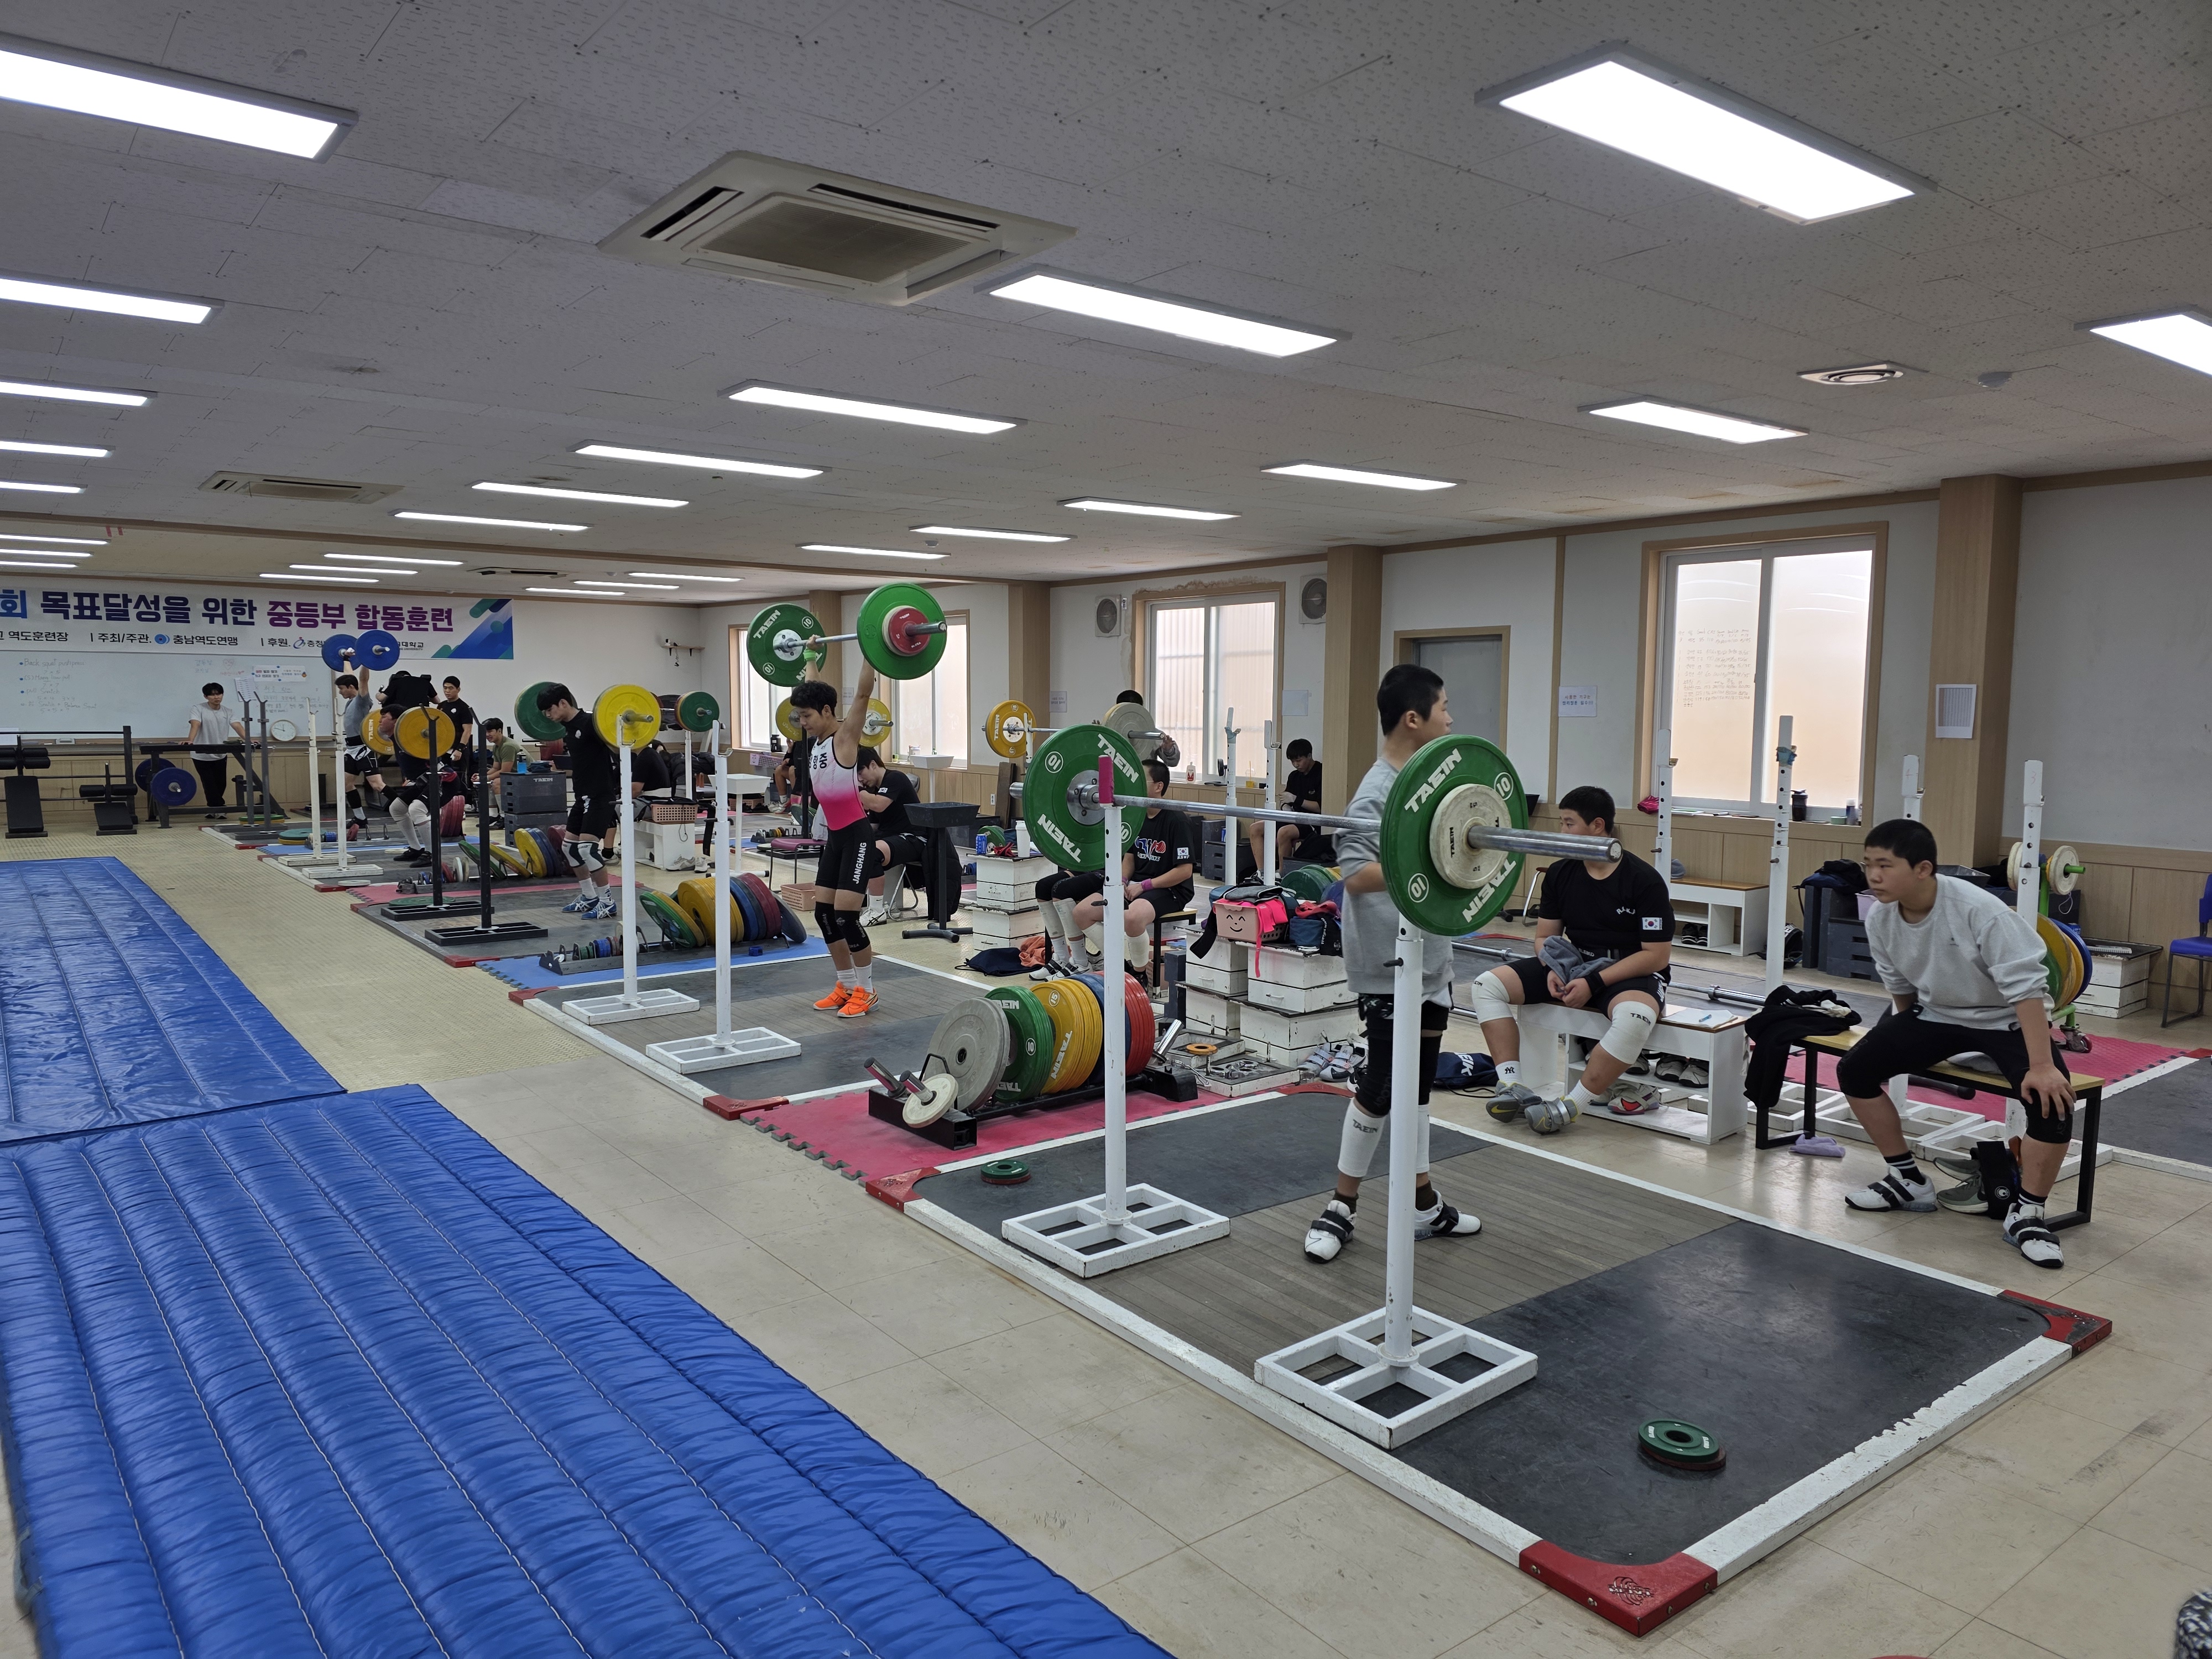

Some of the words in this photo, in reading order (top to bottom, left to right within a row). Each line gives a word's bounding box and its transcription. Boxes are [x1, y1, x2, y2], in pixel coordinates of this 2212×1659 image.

[40, 591, 191, 624] 목표달성을
[201, 598, 257, 626] 위한
[267, 600, 347, 629] 중등부
[354, 604, 453, 632] 합동훈련
[753, 609, 781, 639] TAEIN
[804, 619, 812, 627] 10
[8, 630, 69, 642] 역도훈련장
[173, 635, 238, 646] 충남역도연맹
[764, 664, 774, 673] 10
[796, 653, 822, 681] TIN
[1048, 755, 1061, 770] 10
[1097, 733, 1139, 783] TAEIN
[1404, 748, 1462, 813] TAEIN
[1496, 777, 1511, 797] 10
[1037, 813, 1081, 863] TAEIN
[853, 842, 867, 884] JANGHANG
[1411, 877, 1426, 898] 10
[1462, 859, 1516, 923] TAEIN
[1051, 993, 1057, 1004] 15
[1630, 1013, 1651, 1026] TAEIN
[1027, 1042, 1034, 1052] 10
[1051, 1030, 1072, 1079] TAEIN
[996, 1081, 1021, 1092] TAE
[1353, 1119, 1379, 1133] TAEIN
